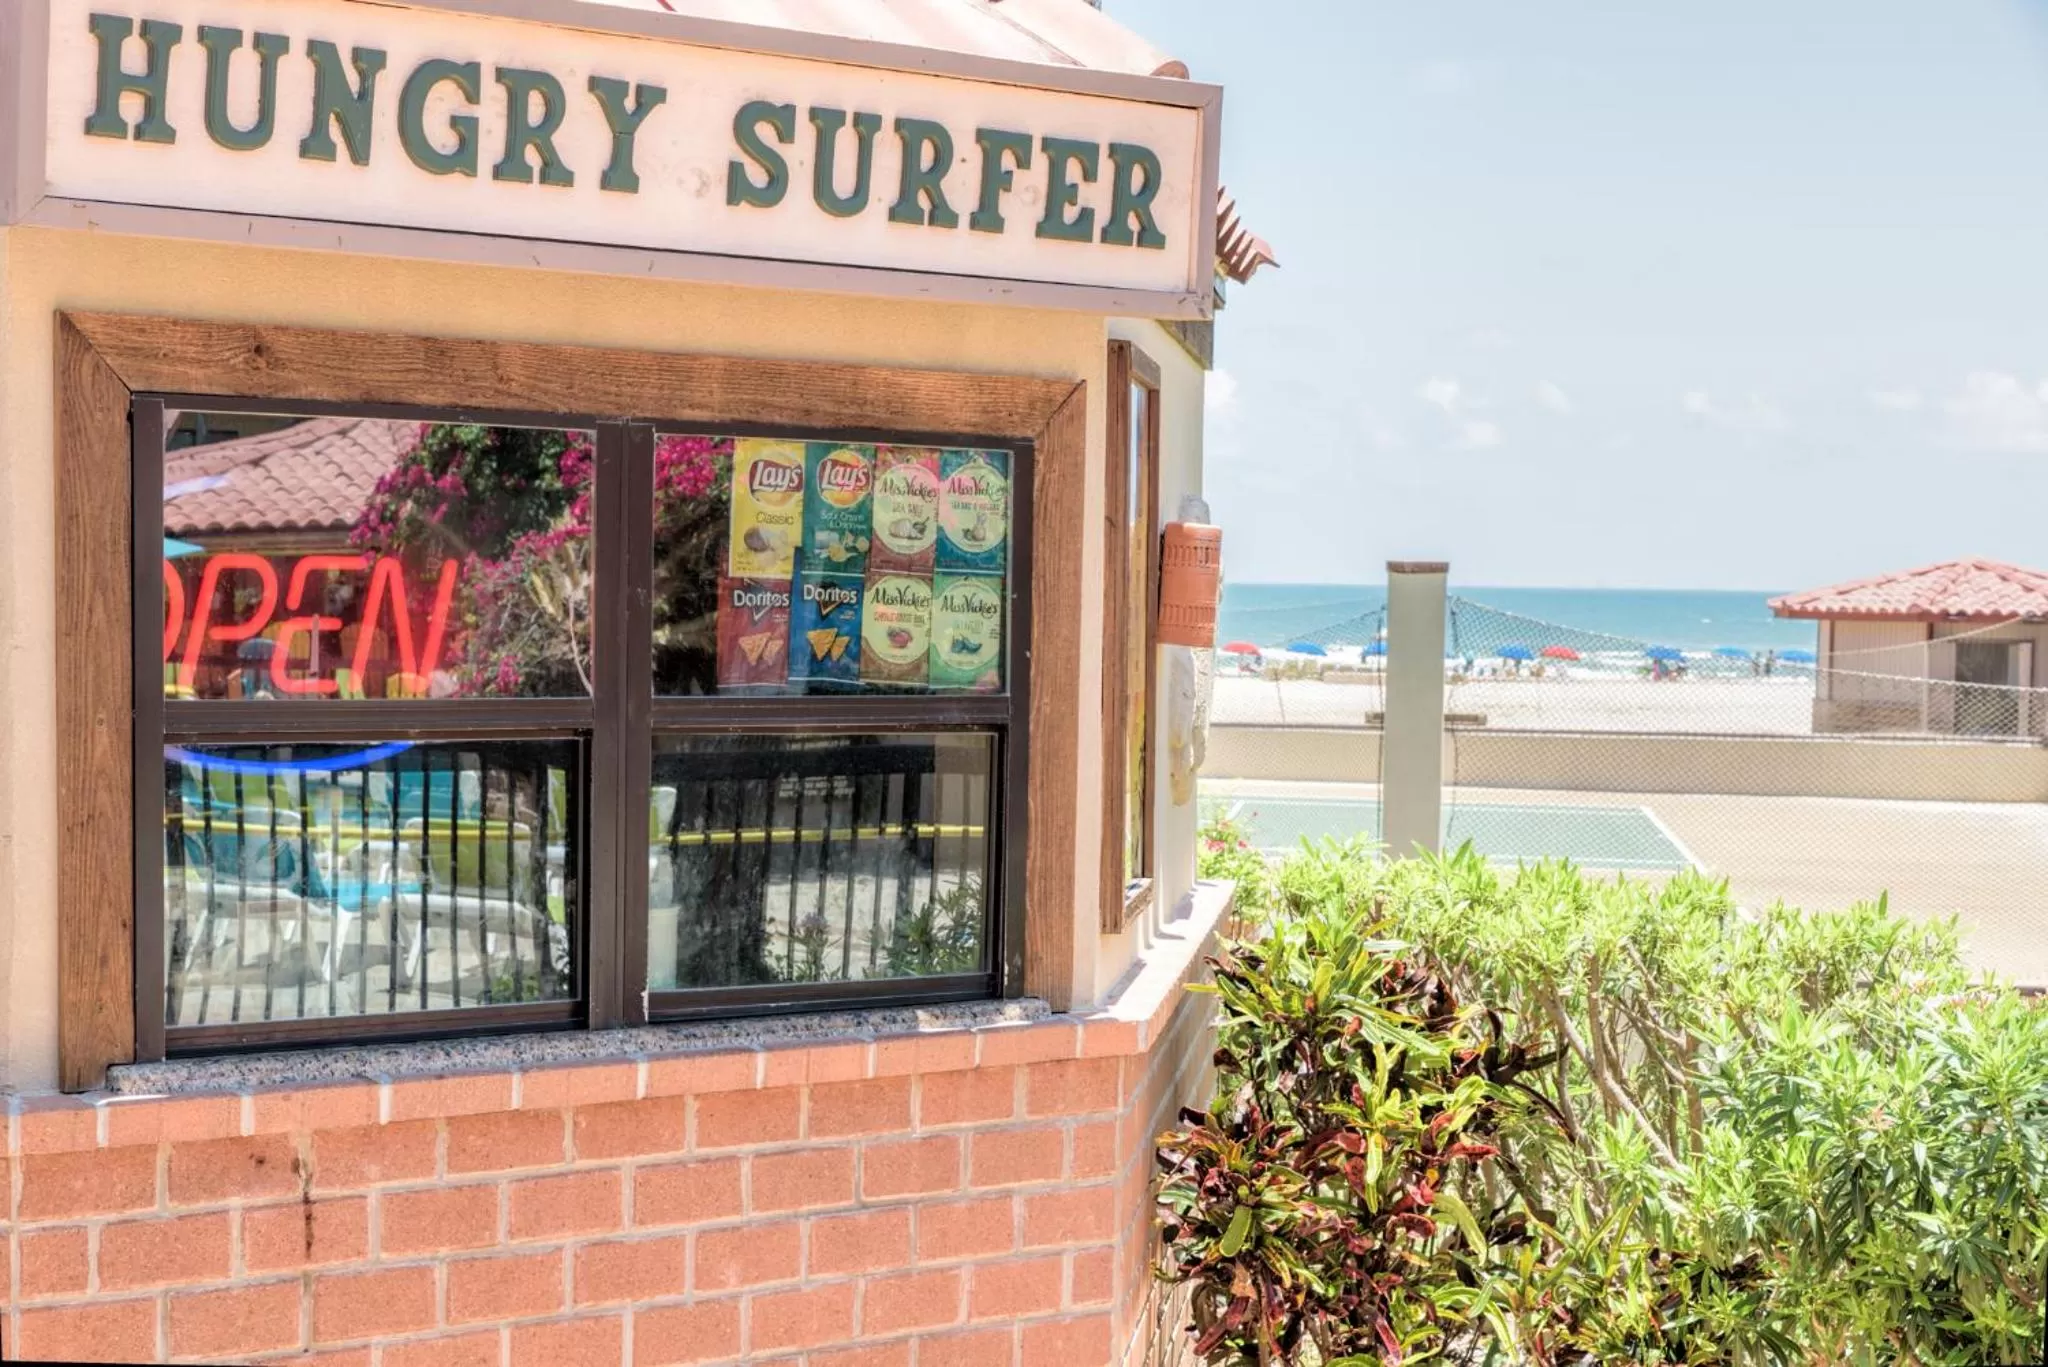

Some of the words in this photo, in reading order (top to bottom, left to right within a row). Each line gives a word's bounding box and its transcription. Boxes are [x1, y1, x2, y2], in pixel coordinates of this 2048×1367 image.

[84, 12, 668, 195] HUNGRY
[726, 100, 1166, 250] SURFER
[753, 461, 802, 493] Lay's
[822, 460, 868, 491] Lay's
[756, 512, 794, 525] Classic
[733, 589, 789, 607] Doritos
[803, 583, 857, 603] Doritos
